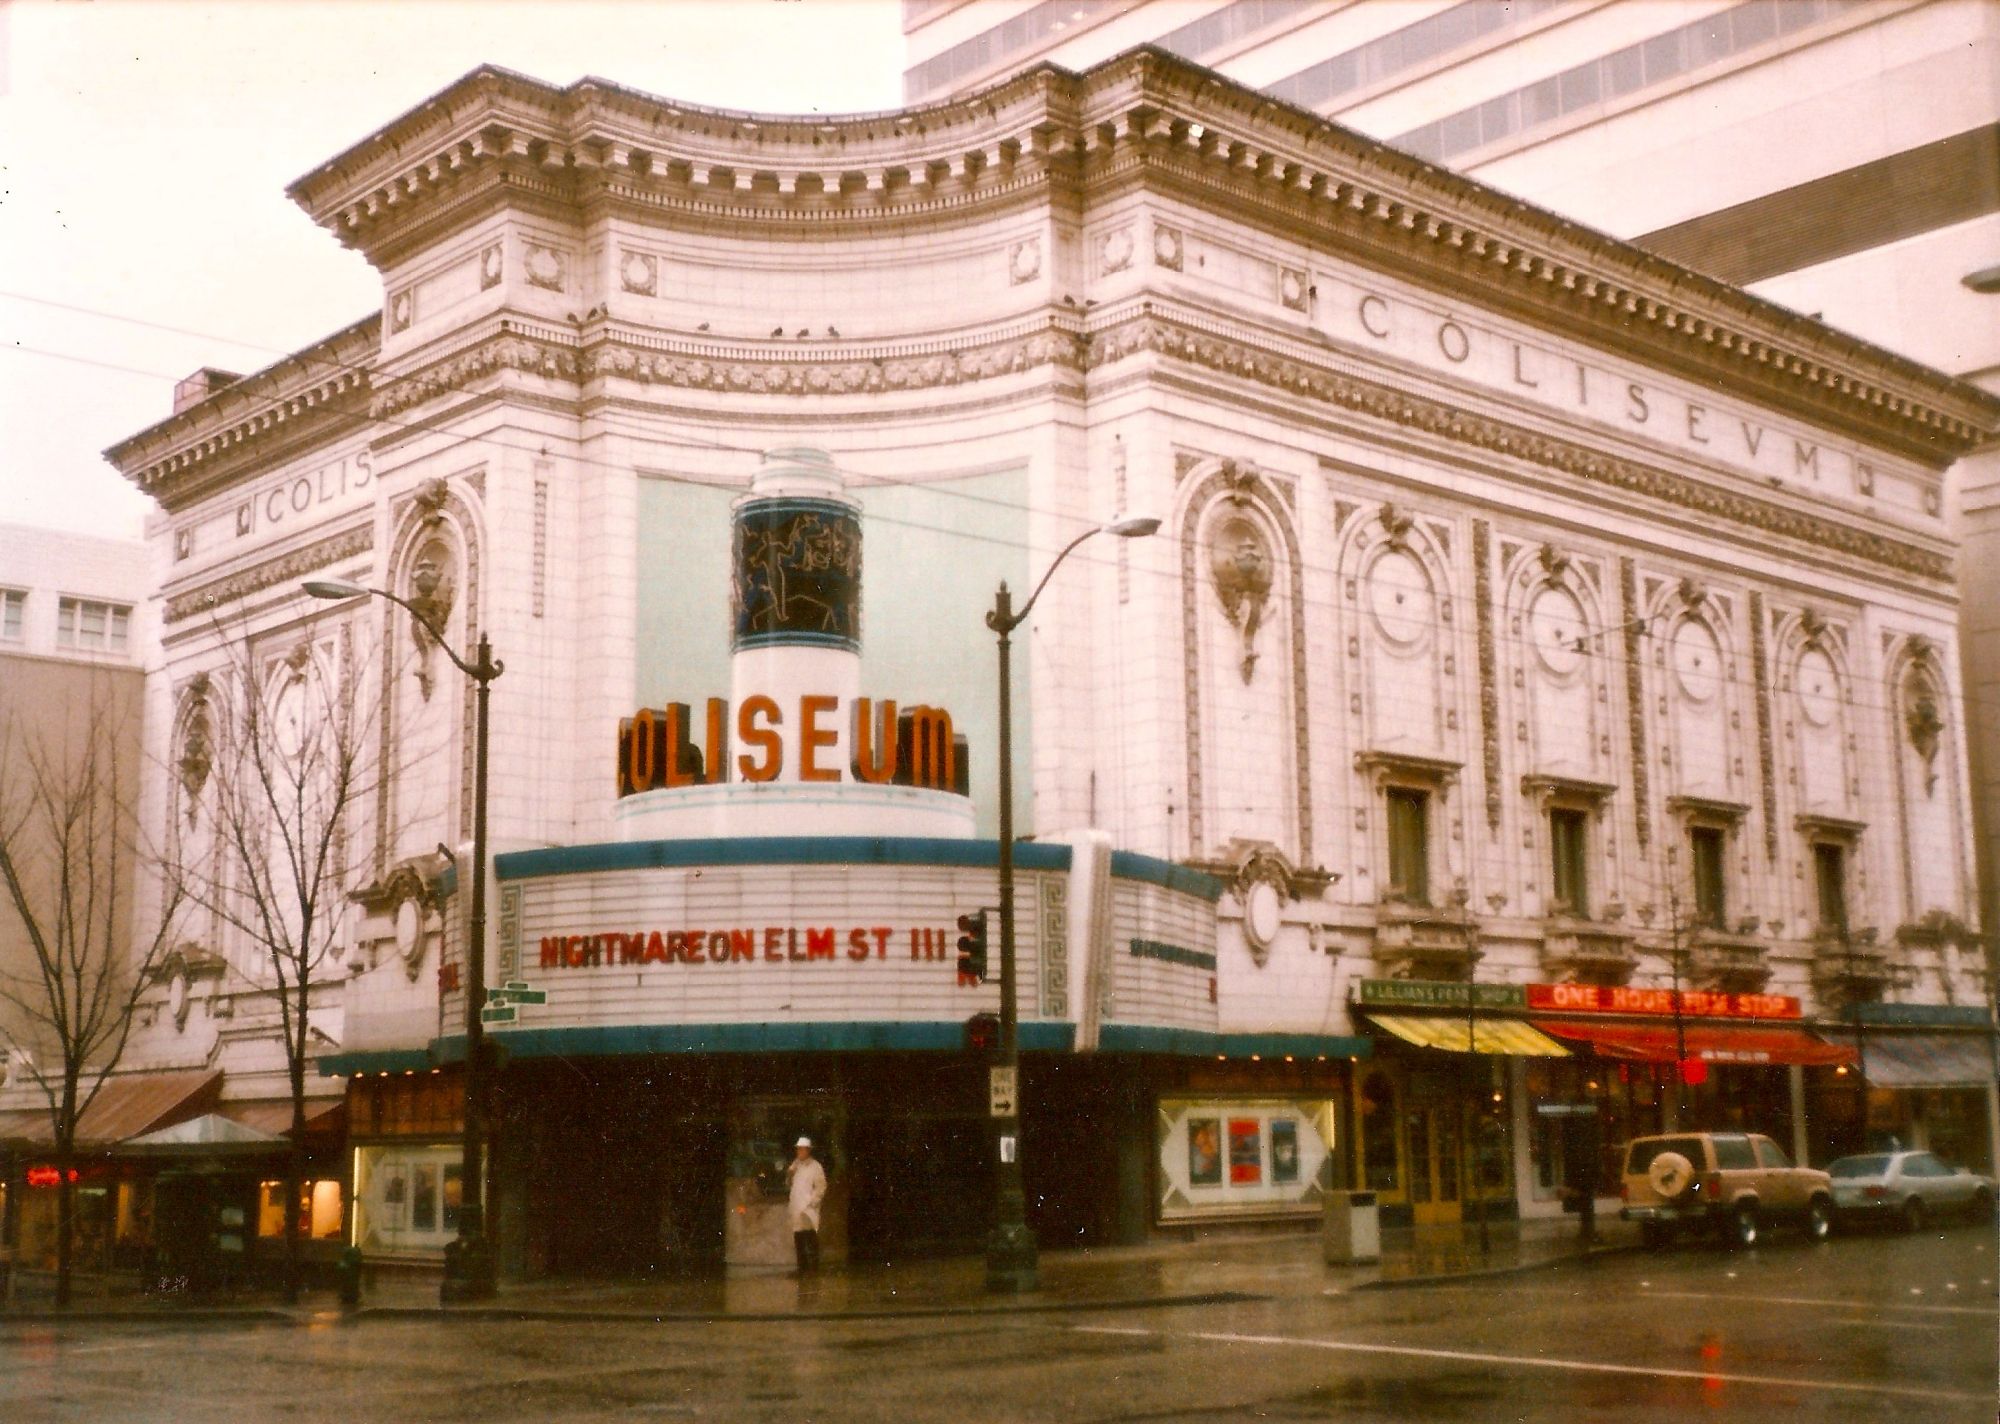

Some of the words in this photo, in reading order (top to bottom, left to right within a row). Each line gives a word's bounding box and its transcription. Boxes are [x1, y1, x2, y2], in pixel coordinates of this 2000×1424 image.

[1357, 293, 1821, 481] COLISEVM
[539, 929, 706, 969] NIGHTMARE
[708, 927, 755, 963] ON
[764, 926, 835, 963] ELM
[846, 926, 894, 962] ST
[910, 926, 946, 962] III
[1552, 986, 1599, 1007] ONE
[1737, 994, 1787, 1014] STOP
